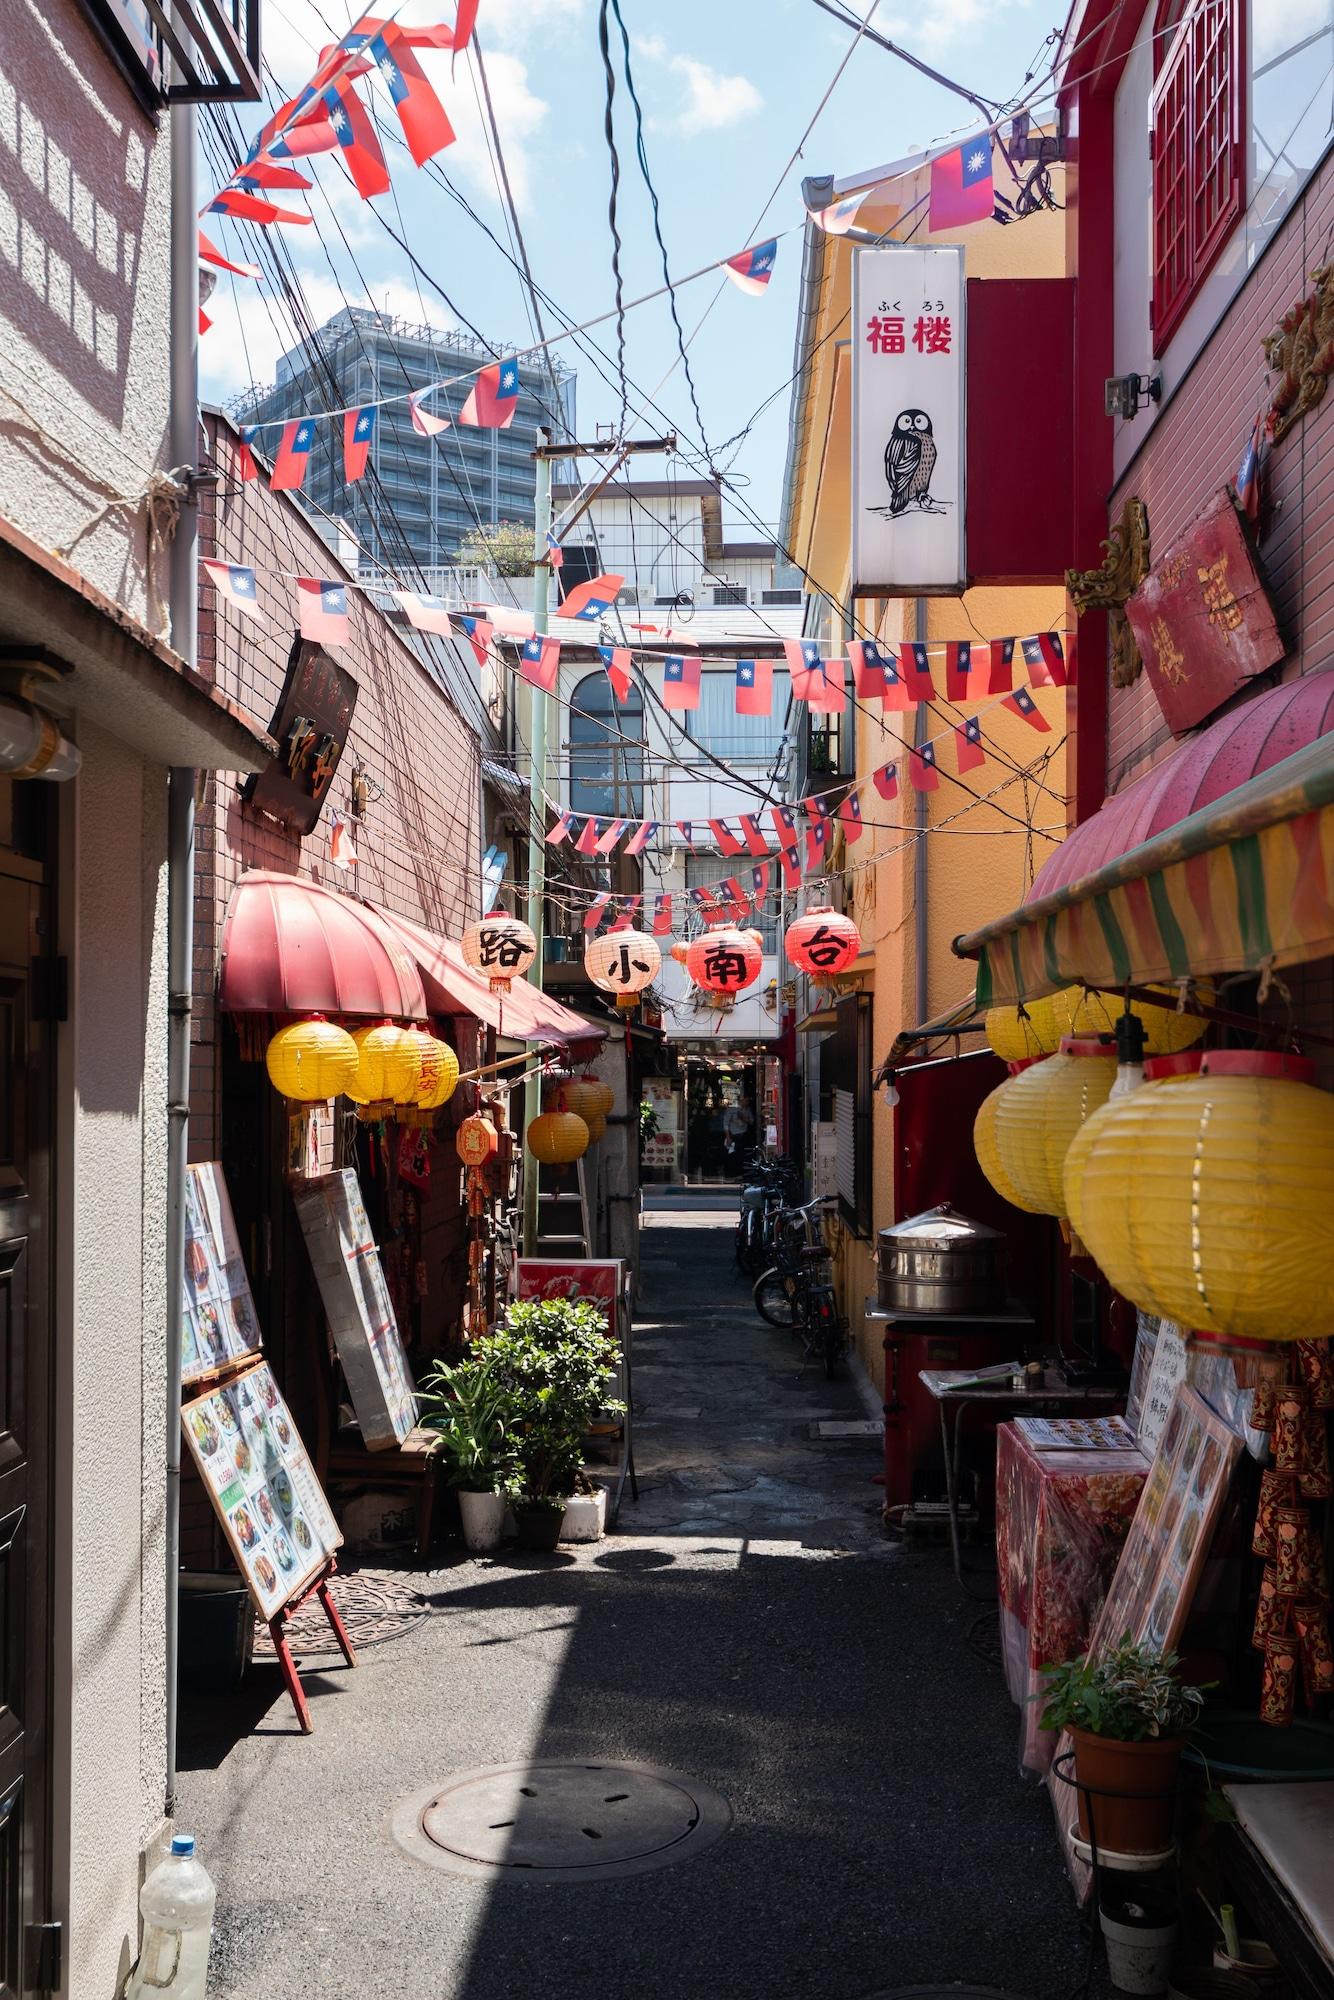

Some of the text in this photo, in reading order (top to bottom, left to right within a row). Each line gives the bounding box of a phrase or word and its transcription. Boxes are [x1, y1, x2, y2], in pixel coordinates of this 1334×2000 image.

[878, 300, 944, 311] ふく ろう
[866, 316, 951, 354] 福楼
[479, 927, 534, 967] 路
[608, 944, 650, 984] 小
[704, 941, 747, 985] 南
[802, 925, 848, 967] 台
